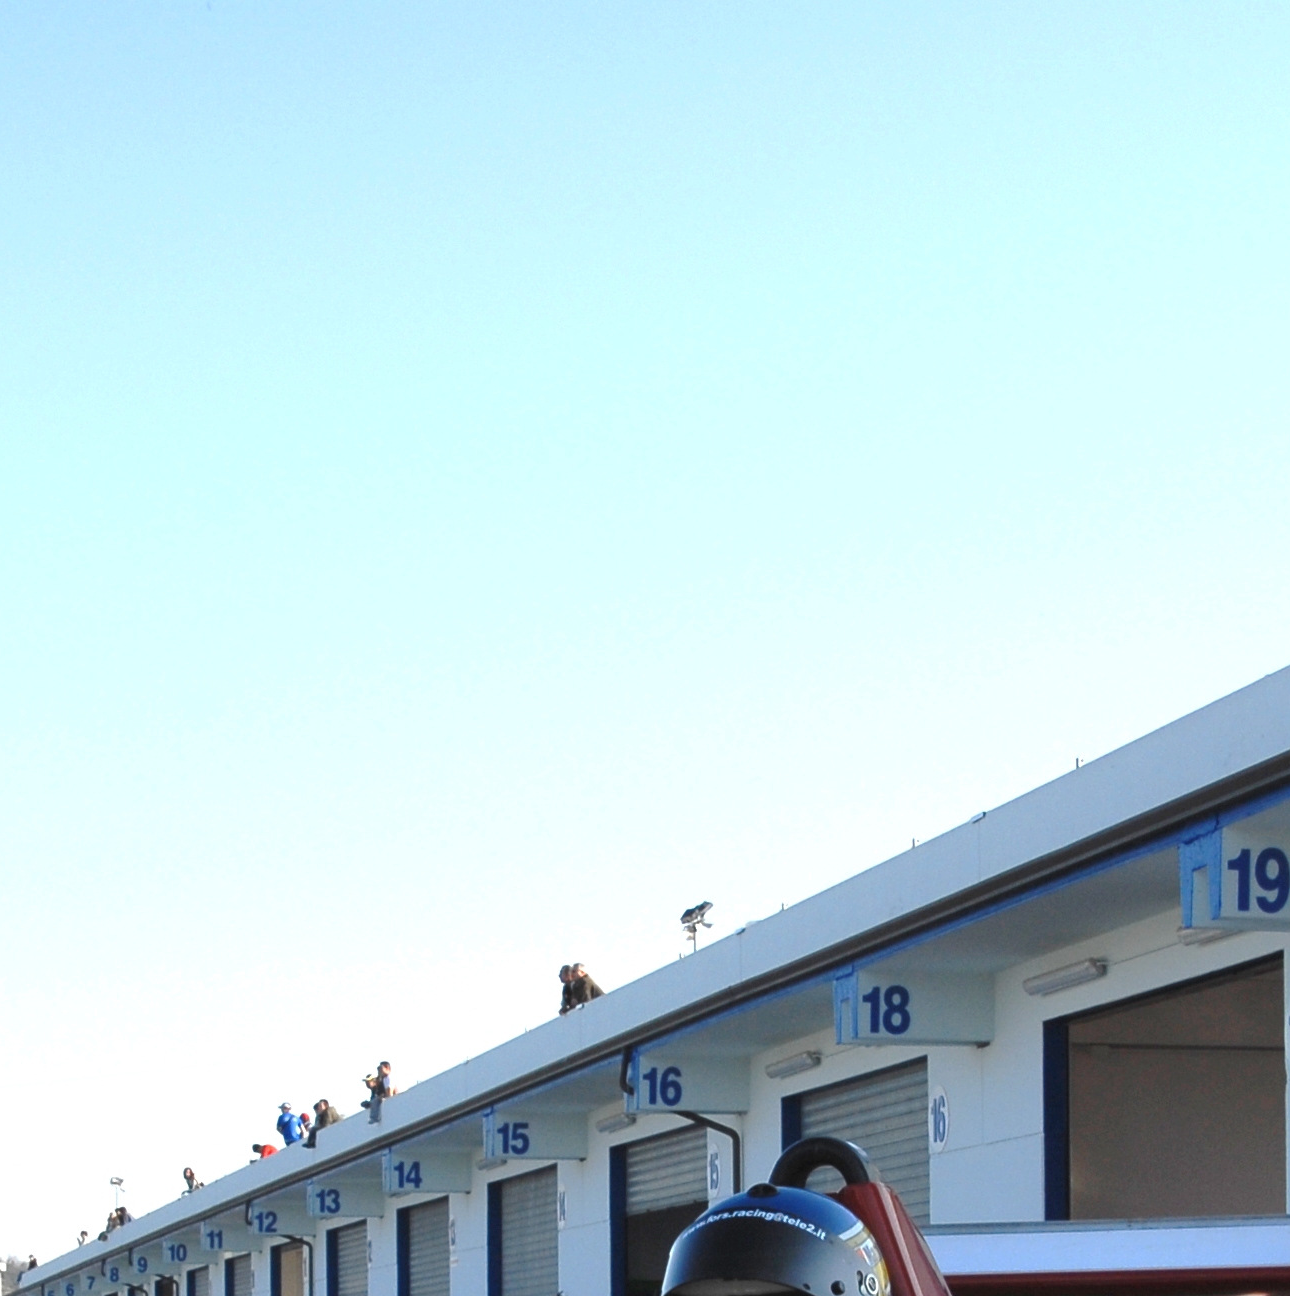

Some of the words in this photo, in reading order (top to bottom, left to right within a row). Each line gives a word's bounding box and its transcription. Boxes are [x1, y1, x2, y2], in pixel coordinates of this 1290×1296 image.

[862, 984, 910, 1036] 18
[642, 1066, 683, 1106] 16
[497, 1122, 530, 1155] 15
[393, 1161, 422, 1189] 14
[315, 1188, 341, 1214] 13
[255, 1211, 277, 1233] 12
[207, 1230, 223, 1249] 11
[168, 1243, 187, 1262] 10
[137, 1256, 147, 1273] 9
[86, 1276, 95, 1290] 7
[109, 1267, 119, 1283] 8
[65, 1284, 75, 1296] 6
